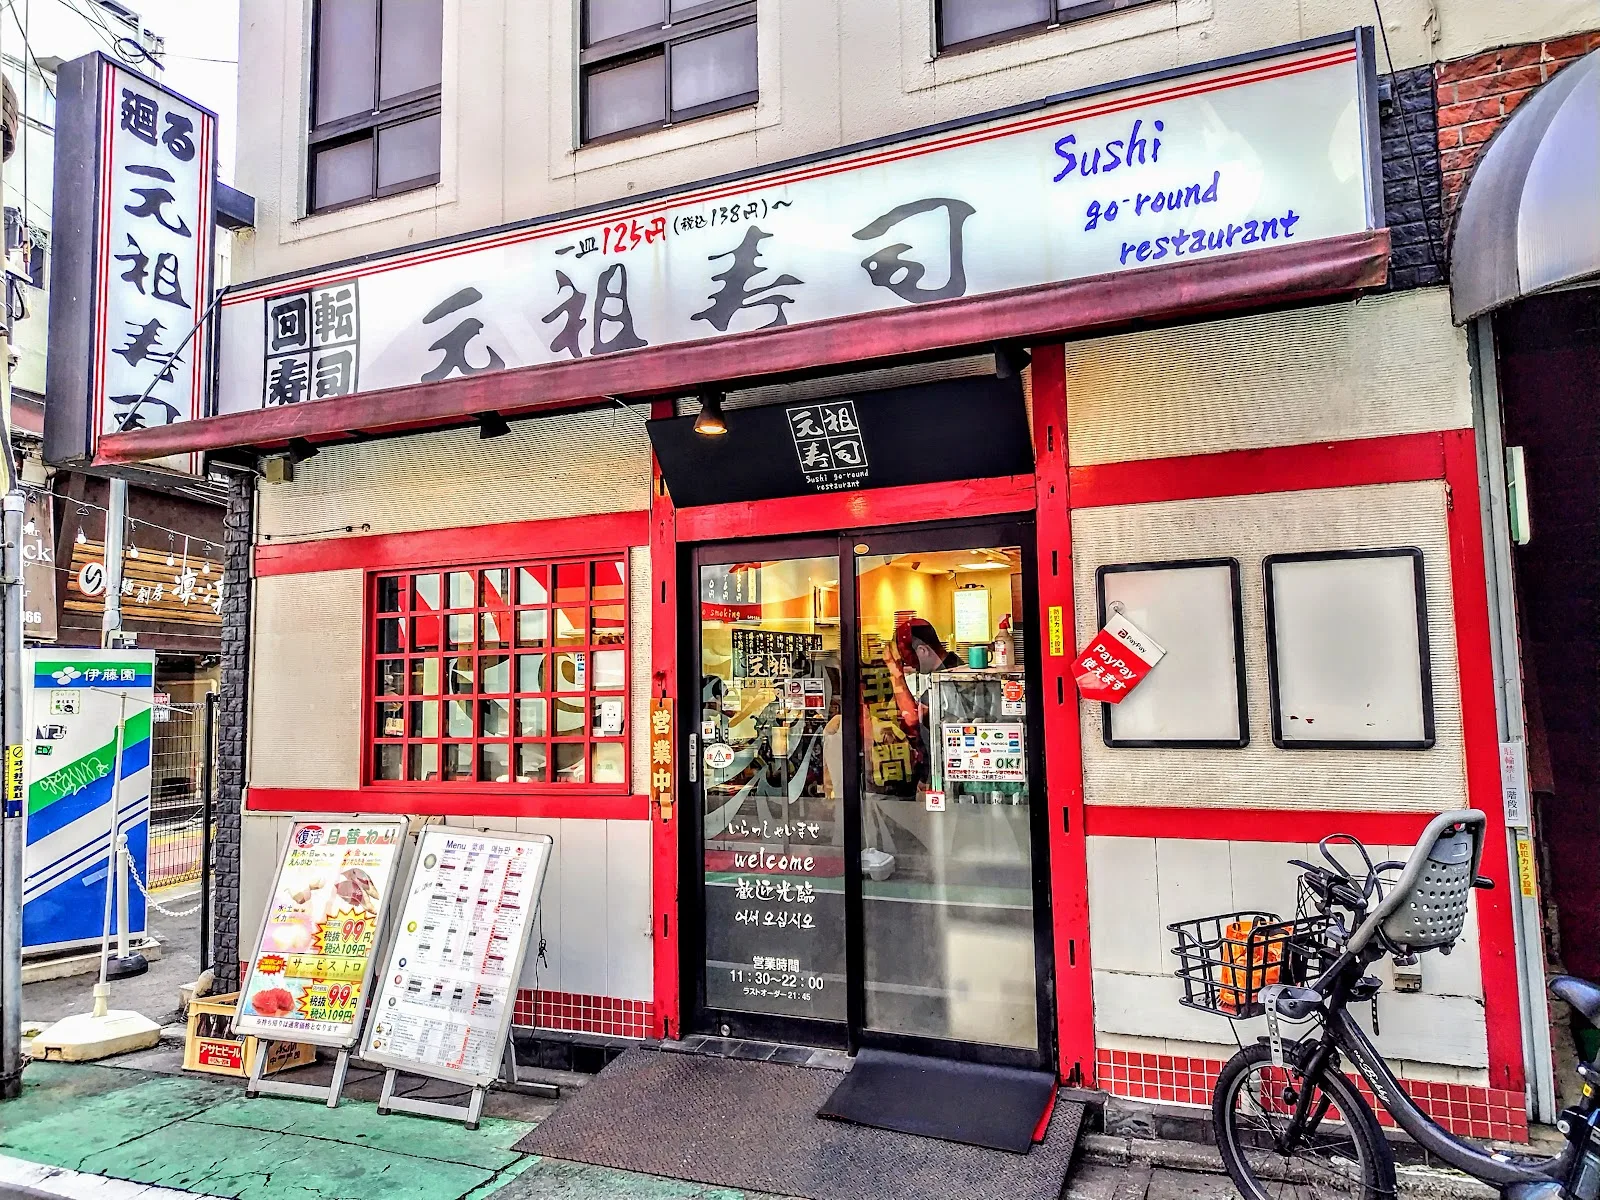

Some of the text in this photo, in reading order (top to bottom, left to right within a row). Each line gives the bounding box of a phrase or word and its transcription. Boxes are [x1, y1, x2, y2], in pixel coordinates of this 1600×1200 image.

[121, 87, 196, 162] 廻る
[1053, 120, 1164, 182] Sushi
[1085, 170, 1220, 231] go-round
[555, 236, 599, 258] 一皿
[603, 217, 667, 255] 125円
[1120, 210, 1300, 265] restaurant
[421, 197, 976, 382] 元祖寿司
[271, 288, 354, 351] 回転
[269, 350, 353, 406] 寿司
[792, 407, 858, 437] 元祖
[802, 440, 861, 467] 寿司
[806, 469, 869, 483] Sushi go-round
[817, 480, 860, 491] restaurant
[1126, 635, 1147, 653] PayPay
[84, 668, 135, 682] 伊藤園
[1081, 657, 1126, 691] 使えます
[1093, 644, 1137, 680] PayPay
[652, 709, 671, 793] 営業中
[996, 758, 1021, 769] OK!
[327, 828, 396, 845] 日替わり
[728, 819, 820, 839] いらっしゃいませ
[446, 840, 466, 850] Menu
[734, 847, 815, 871] welcome
[1520, 842, 1532, 896] 防犯カメラ設置
[735, 909, 816, 930] 어서 오십시오
[293, 958, 361, 973] サービストロ
[753, 955, 800, 973] 営業時間
[200, 1043, 240, 1058] アサヒビール
